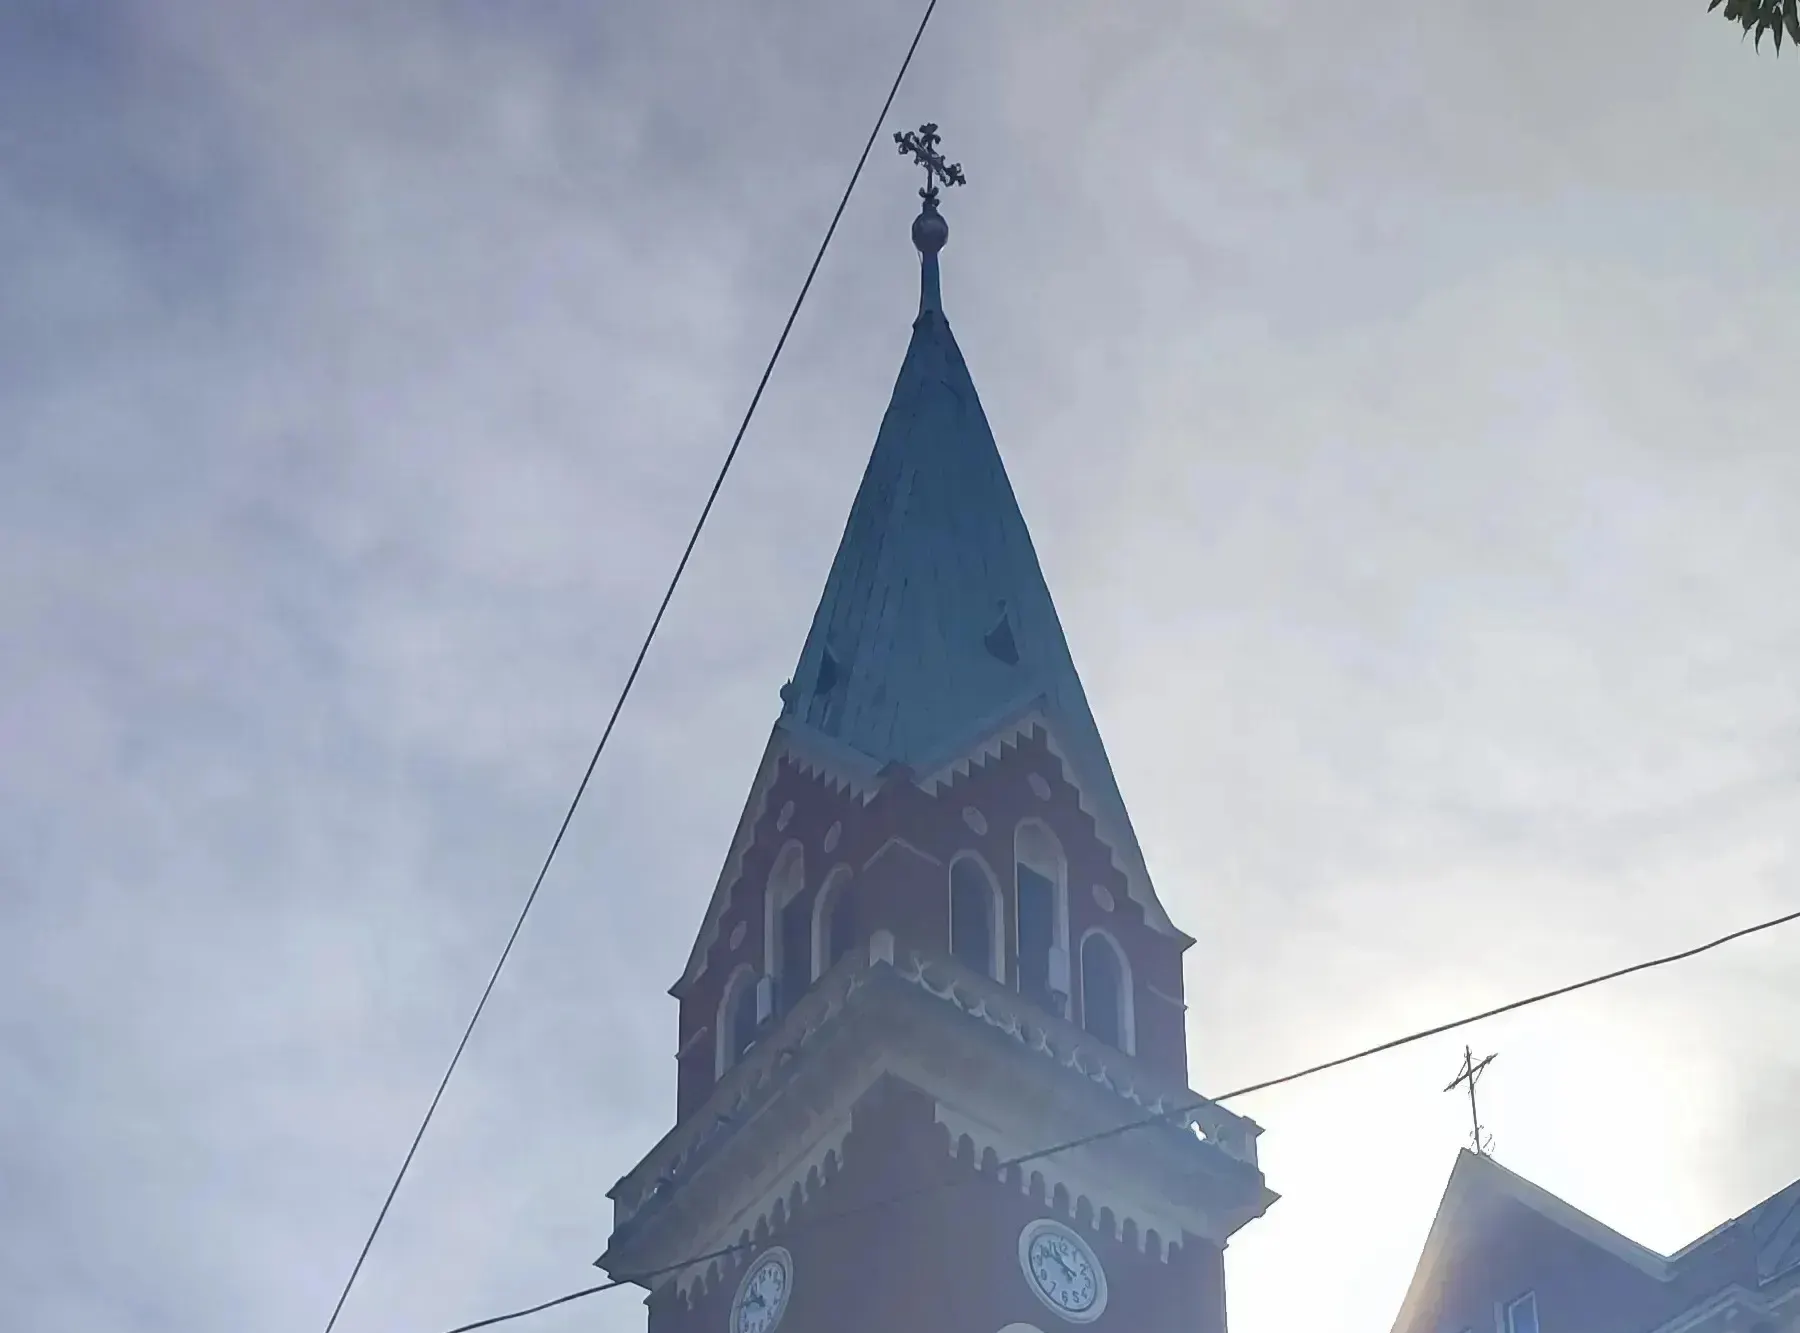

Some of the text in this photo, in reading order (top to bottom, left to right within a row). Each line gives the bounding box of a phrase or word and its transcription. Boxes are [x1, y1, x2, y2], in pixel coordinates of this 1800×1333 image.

[1080, 1264, 1087, 1276] 2
[1061, 1290, 1068, 1306] 6
[1073, 1290, 1080, 1303] 5
